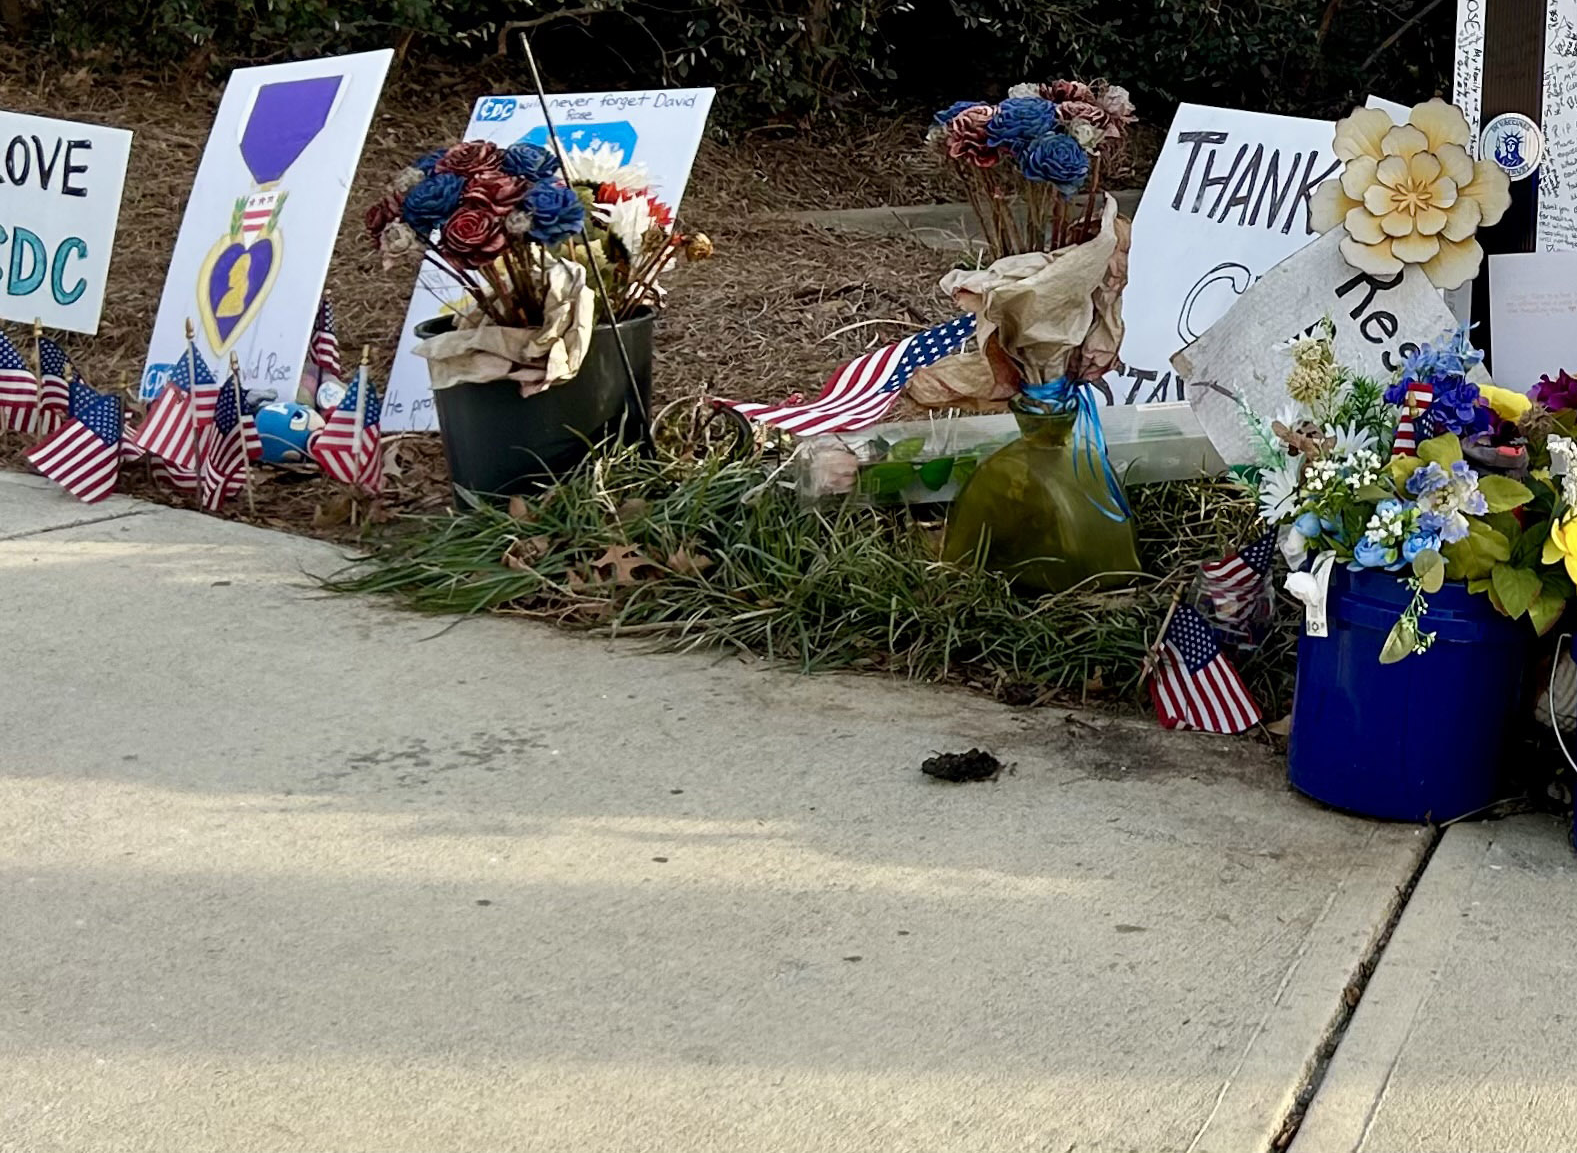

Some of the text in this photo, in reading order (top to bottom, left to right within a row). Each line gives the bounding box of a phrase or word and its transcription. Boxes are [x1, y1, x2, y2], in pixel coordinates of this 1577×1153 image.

[478, 98, 516, 122] CDC
[549, 96, 595, 109] never
[600, 93, 652, 111] forget
[652, 93, 699, 110] David
[0, 135, 92, 197] OVE
[265, 354, 292, 384] Rose
[385, 391, 404, 418] He
